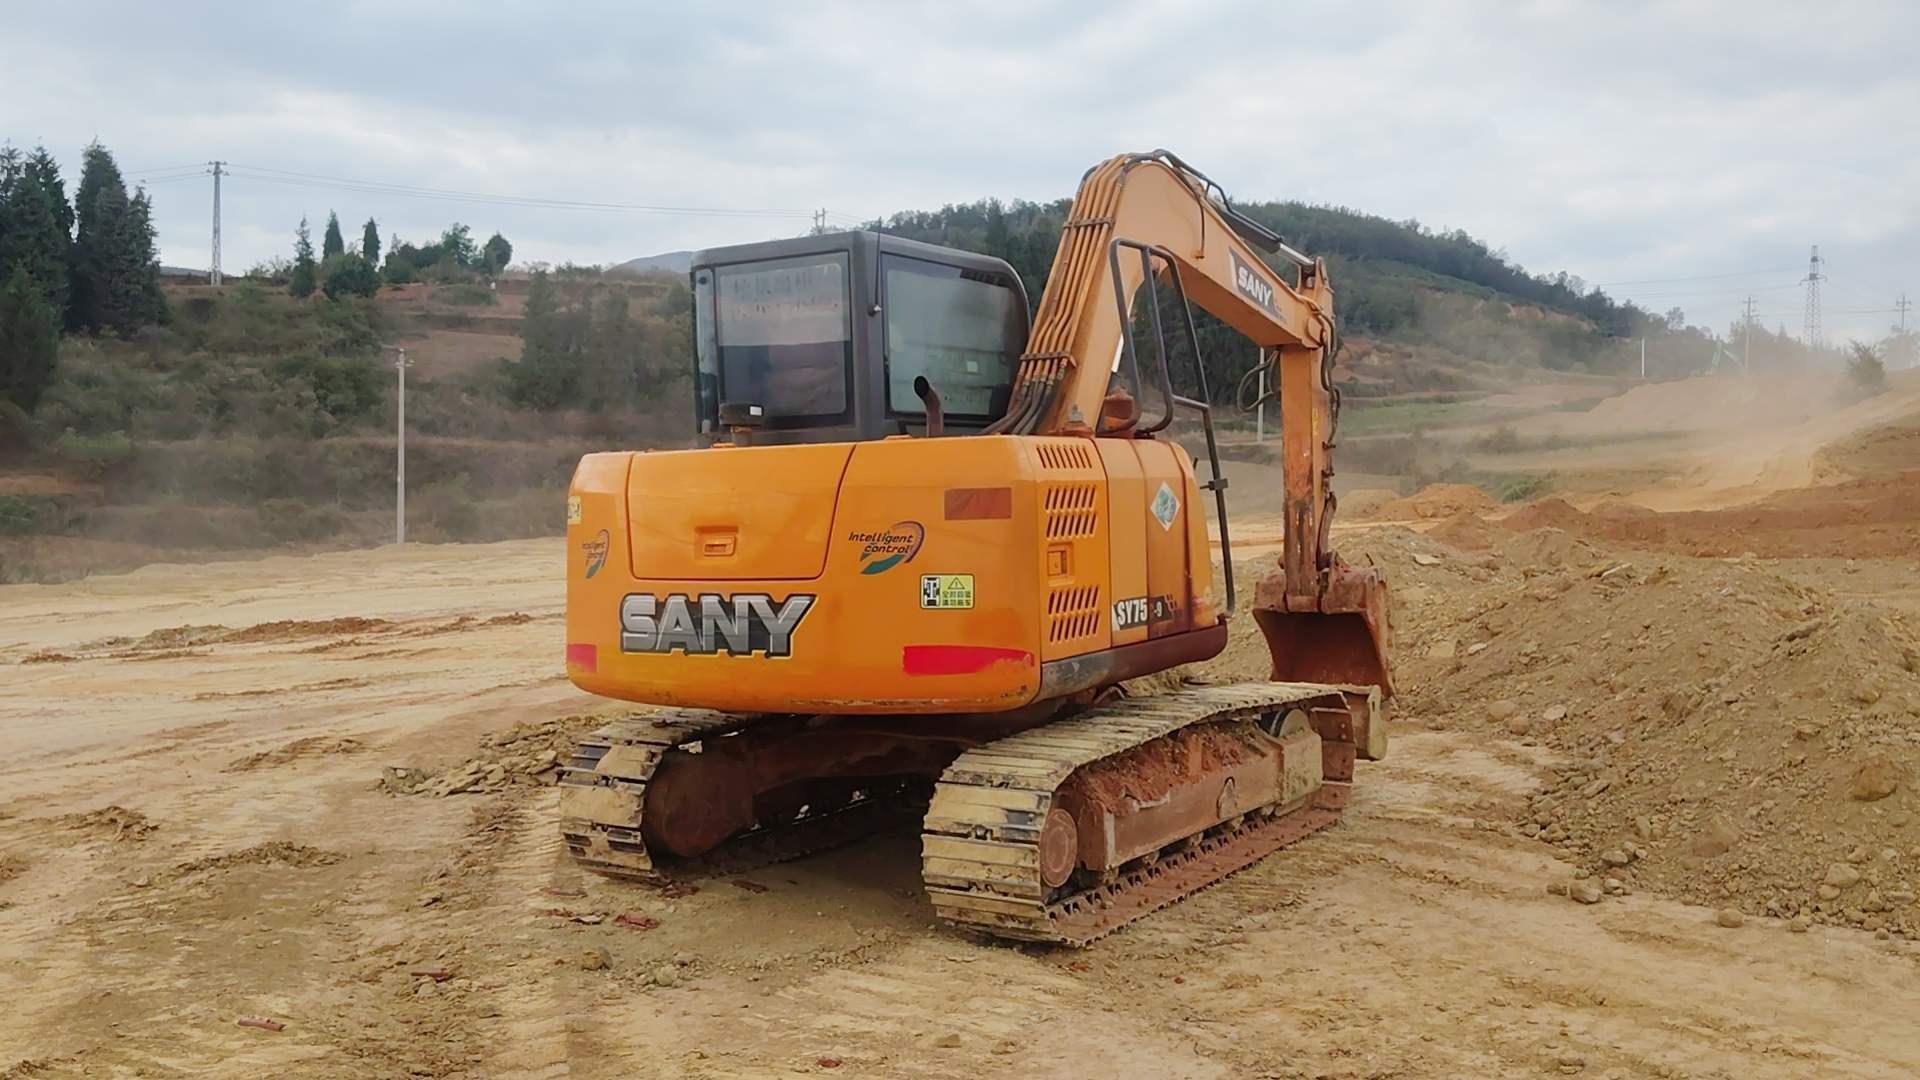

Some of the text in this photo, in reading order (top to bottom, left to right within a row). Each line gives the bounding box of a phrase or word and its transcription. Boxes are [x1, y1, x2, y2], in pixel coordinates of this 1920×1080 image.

[1238, 266, 1272, 306] SANY
[848, 531, 914, 545] Intelligent
[621, 593, 816, 656] SANY
[1117, 598, 1163, 626] SY75-9
